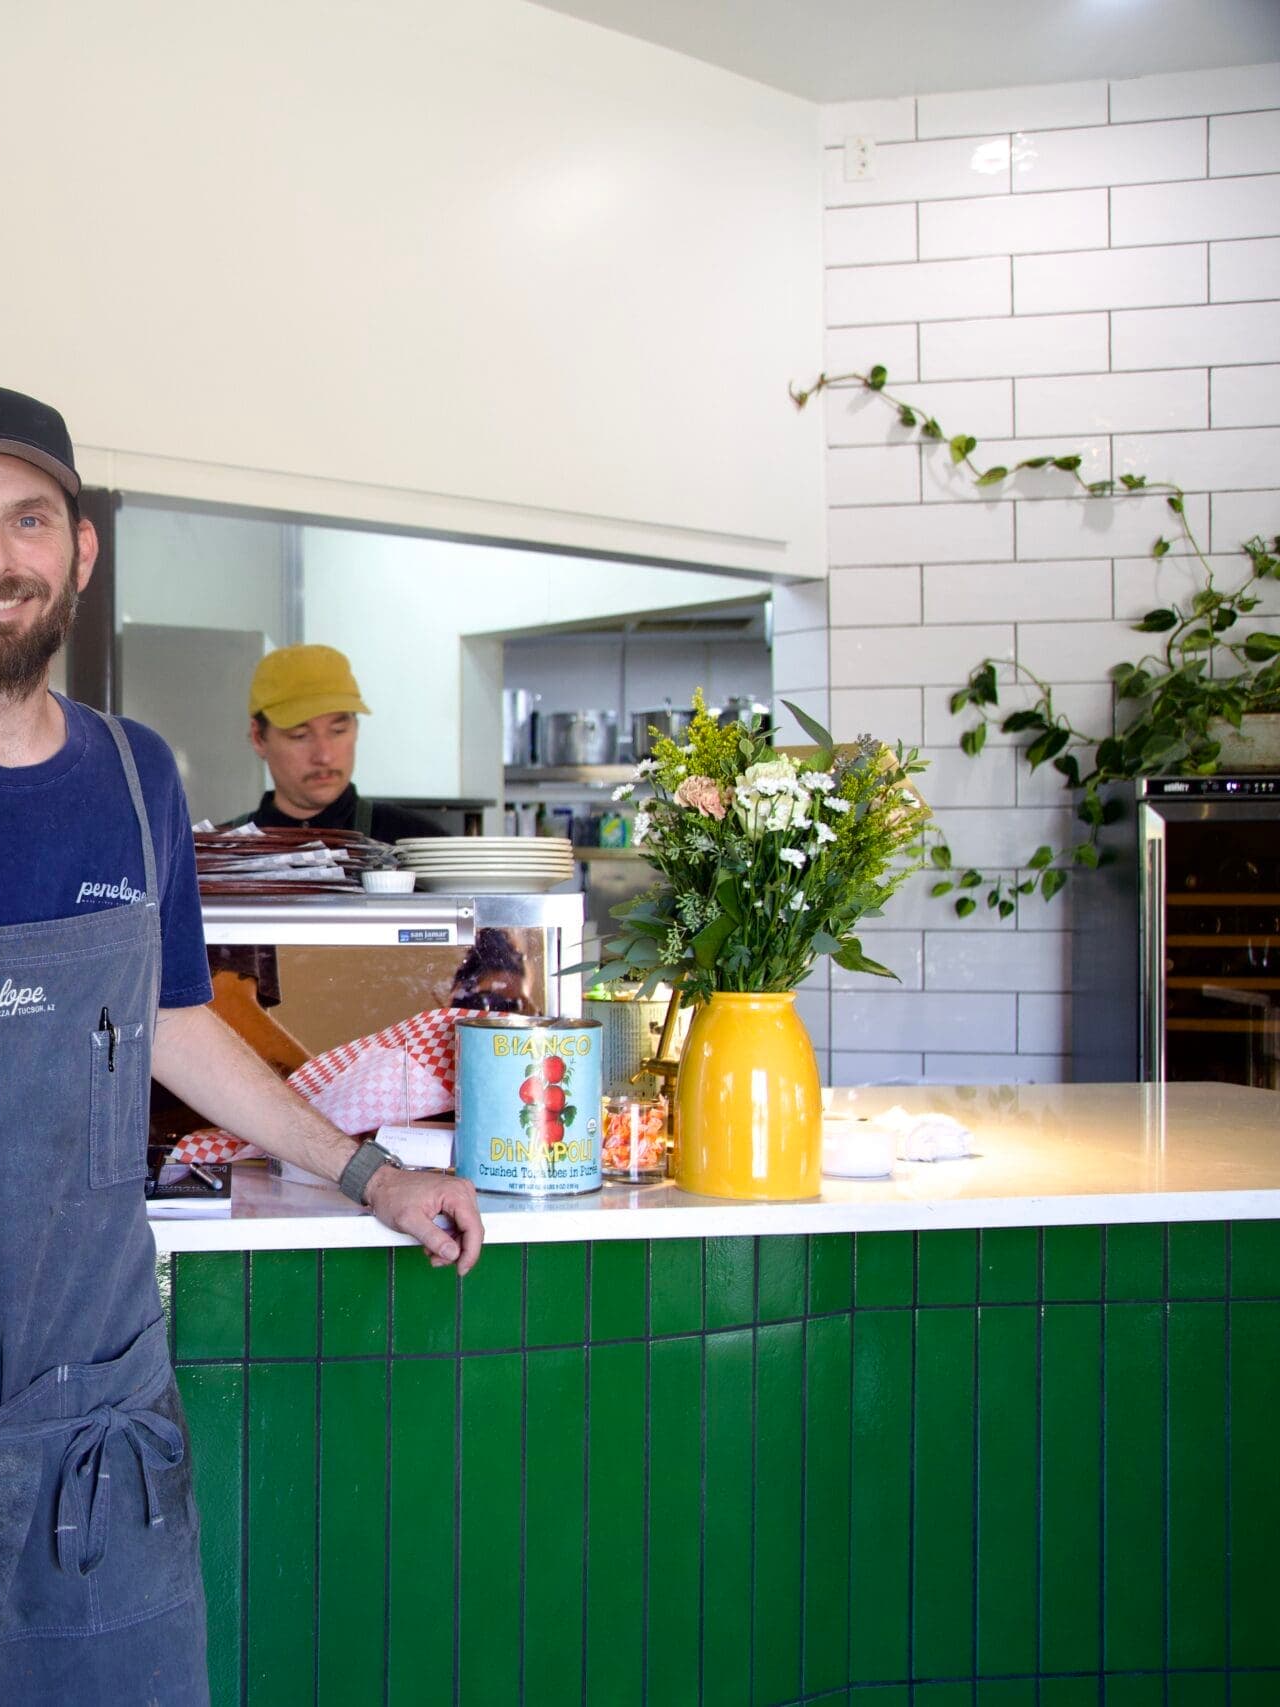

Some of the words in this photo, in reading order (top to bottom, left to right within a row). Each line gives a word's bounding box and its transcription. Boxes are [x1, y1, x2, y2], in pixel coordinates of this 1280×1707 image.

[493, 1034, 591, 1057] BIANCO
[479, 1163, 518, 1178] Crushed
[520, 1166, 568, 1179] Totoes
[569, 1167, 579, 1177] in
